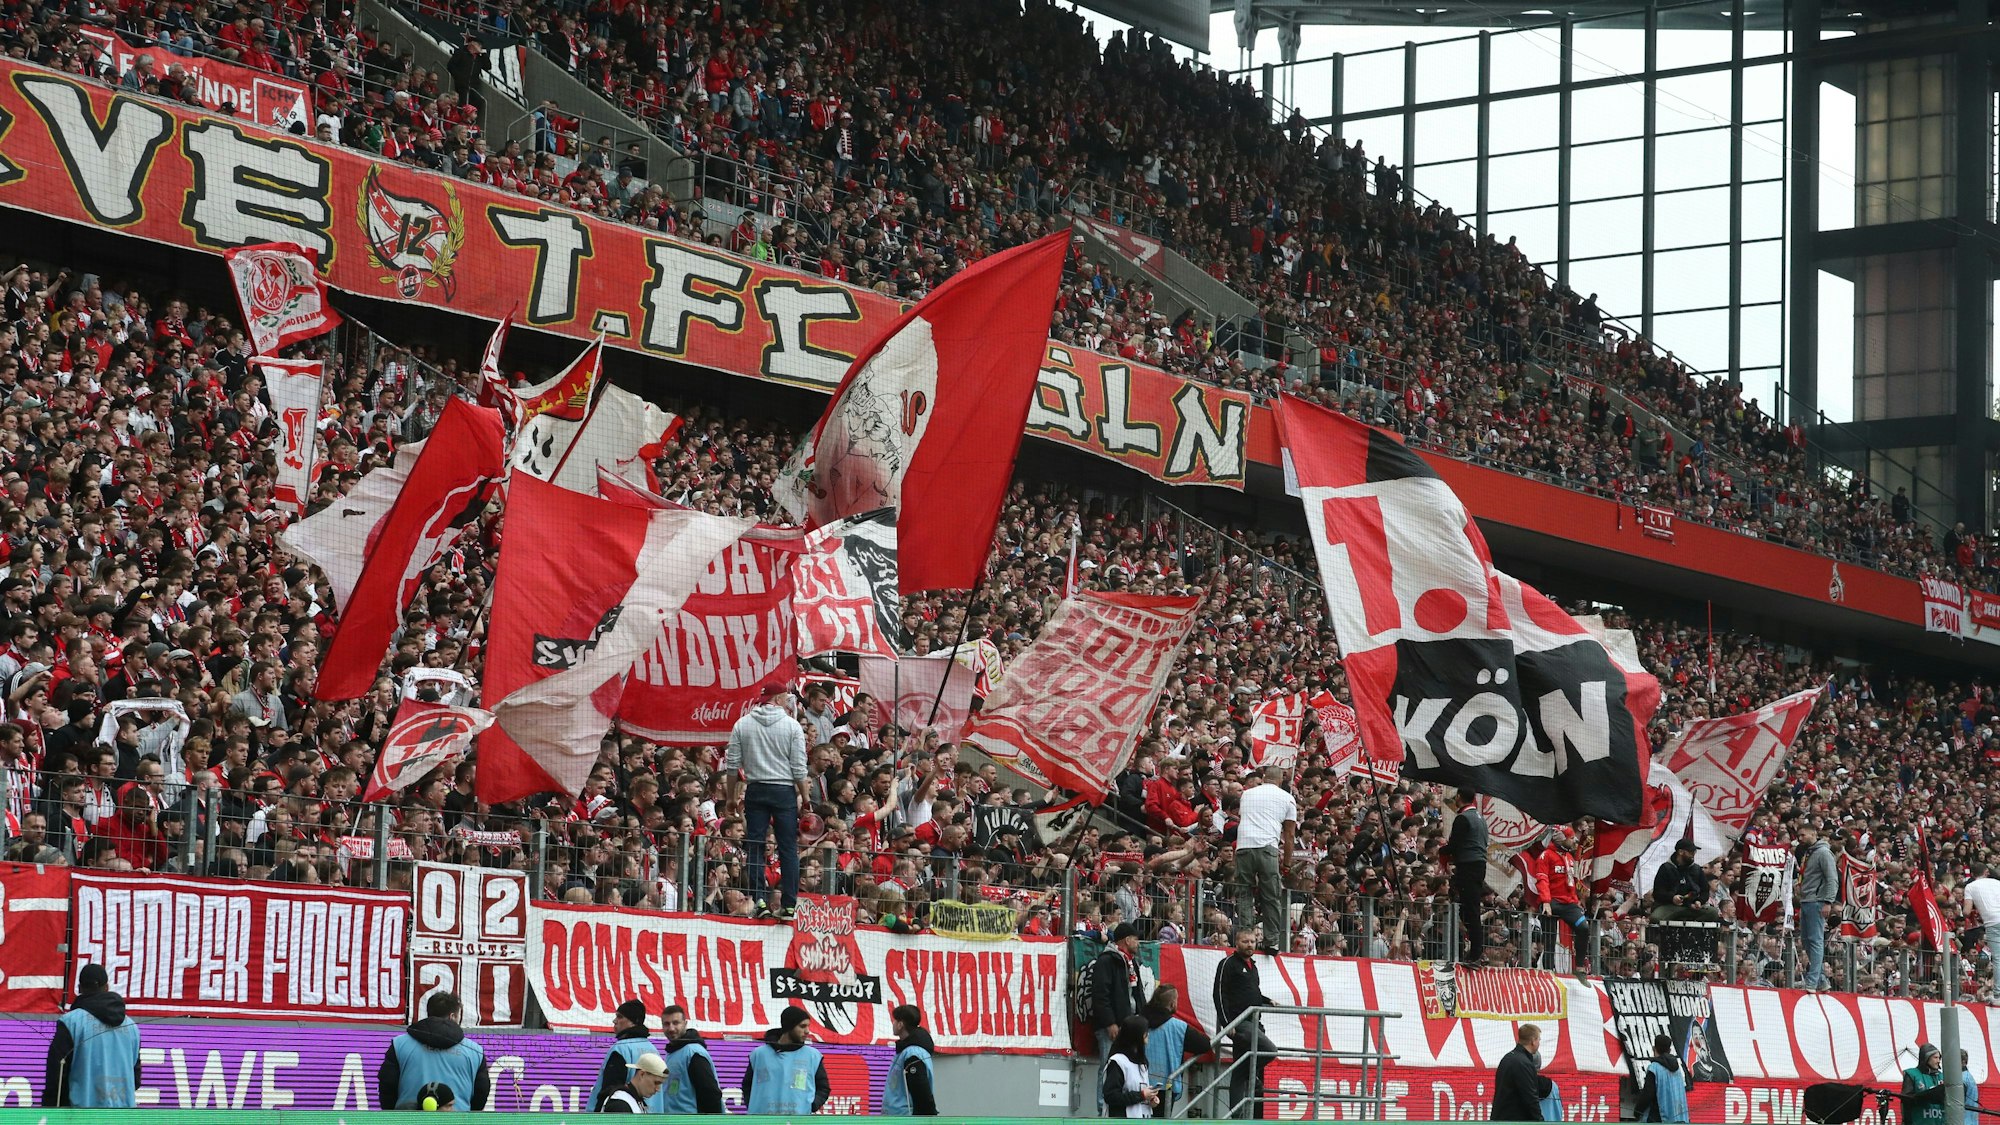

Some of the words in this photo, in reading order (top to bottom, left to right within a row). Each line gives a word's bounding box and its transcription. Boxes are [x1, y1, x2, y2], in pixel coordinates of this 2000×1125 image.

[396, 213, 431, 257] 12
[0, 72, 337, 278] VE
[1026, 345, 1250, 482] ÖLN
[1392, 666, 1611, 779] KÖLN
[485, 878, 520, 935] 2
[76, 885, 251, 1002] SEMPER
[262, 899, 405, 1009] FIDELIS
[542, 919, 770, 1026] DOMSTADT
[886, 947, 1058, 1037] SYNDIKAT
[1421, 967, 1440, 1015] SEK
[1454, 962, 1563, 1015] STADIONVERBOT
[1611, 982, 1669, 1014] SEKTION
[1669, 994, 1711, 1018] MOMO
[1710, 985, 2000, 1084] HORD
[137, 1048, 301, 1109] EWE
